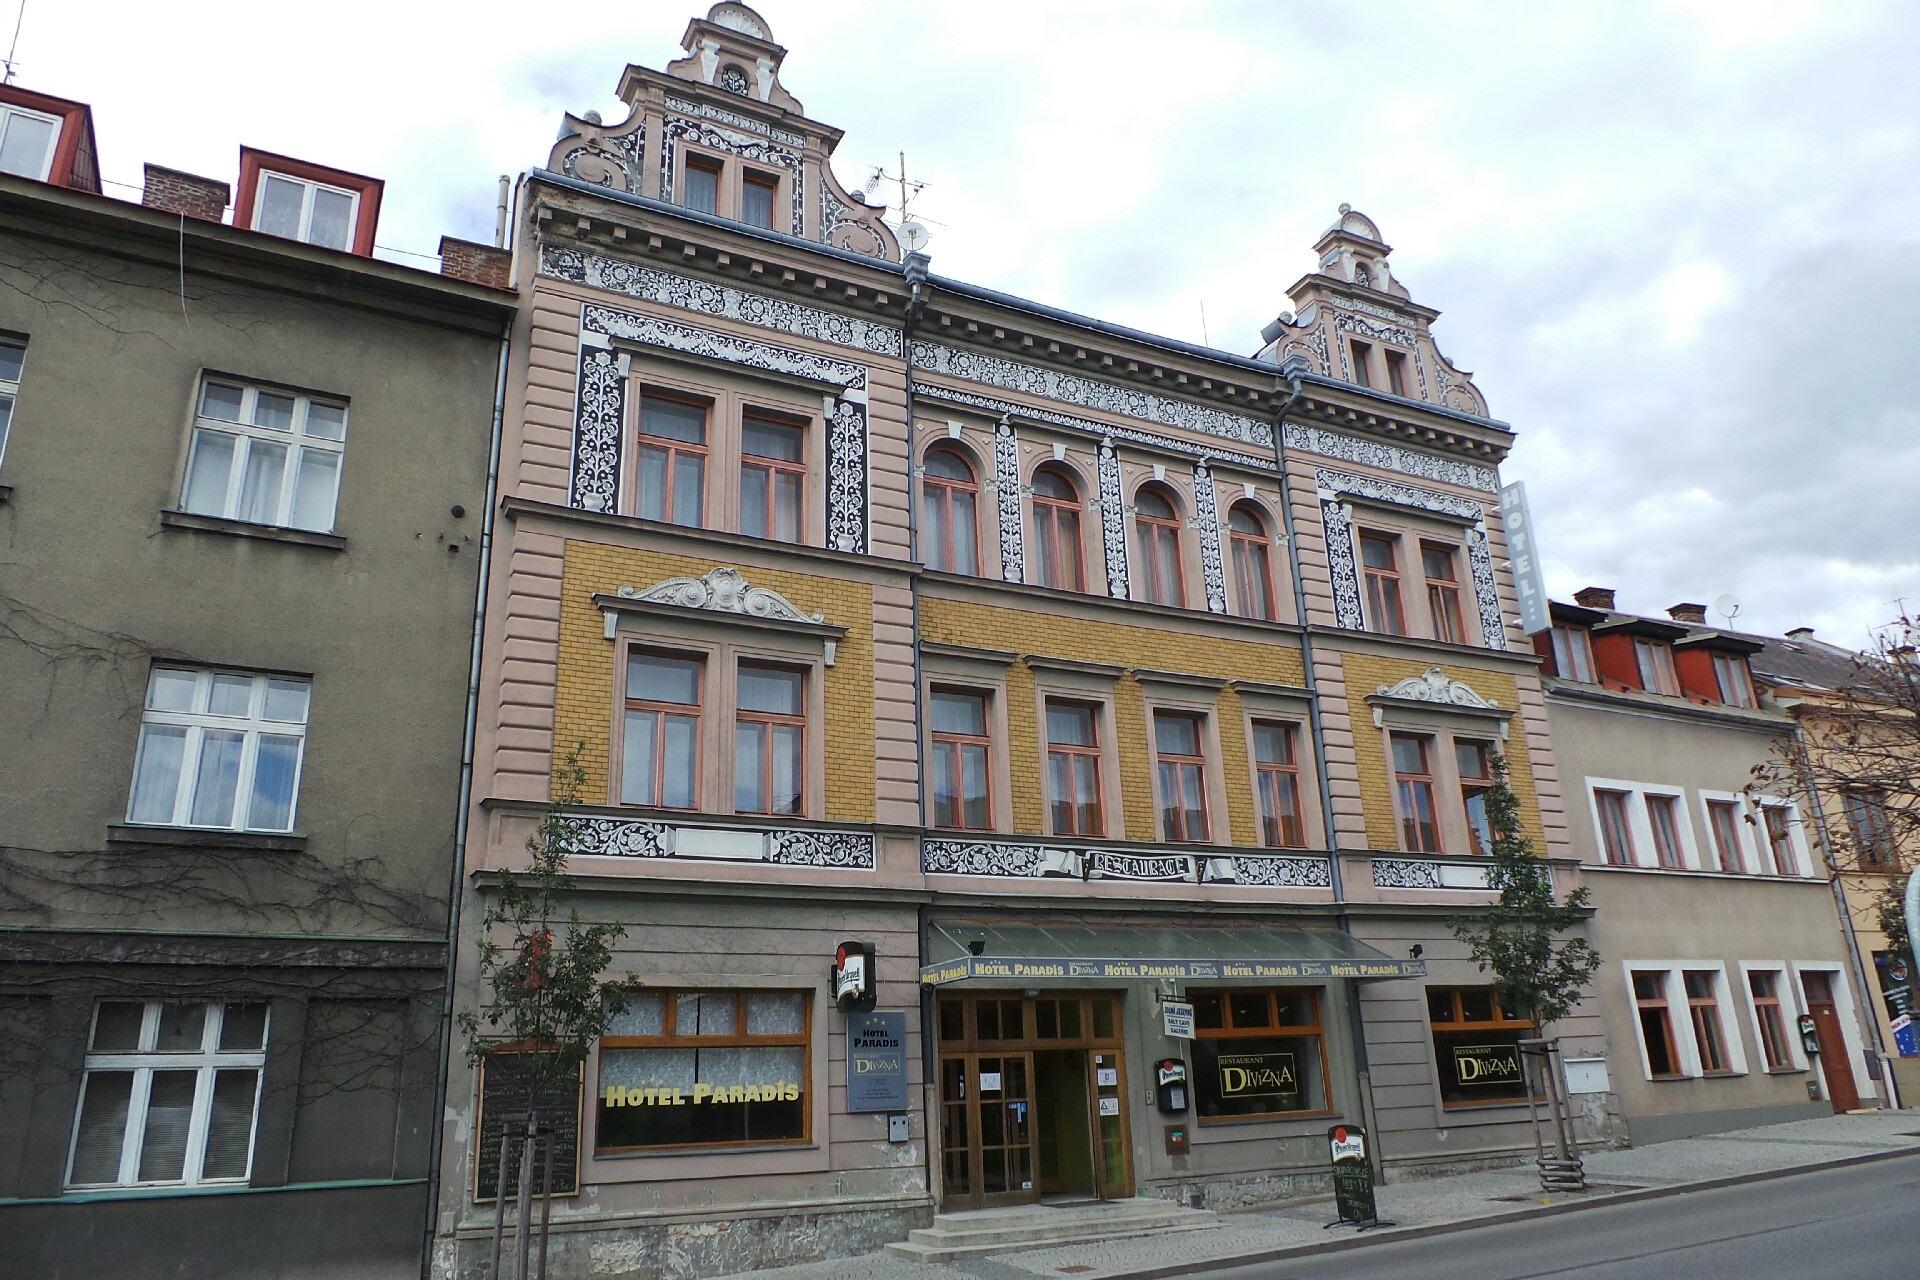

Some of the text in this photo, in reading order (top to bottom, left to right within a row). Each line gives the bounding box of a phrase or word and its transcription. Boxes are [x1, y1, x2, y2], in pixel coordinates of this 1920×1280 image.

[1502, 488, 1535, 598] HOTEL
[1094, 853, 1186, 876] RESTAURACE
[922, 965, 968, 983] HOTEL PARADIS
[975, 963, 1064, 976] HOTEL PARADIS
[1104, 964, 1186, 976] HOTEL PARADIS
[1223, 965, 1298, 976] HOTEL PARADIS
[1331, 965, 1399, 976] HOTEL PARADIS
[863, 1029, 889, 1037] HOTEL
[854, 1038, 899, 1048] PARADIS
[1458, 1056, 1518, 1080] DIVIZNA
[1222, 1065, 1293, 1092] DIVIZNA
[606, 1082, 799, 1107] HOTEL PARADIS
